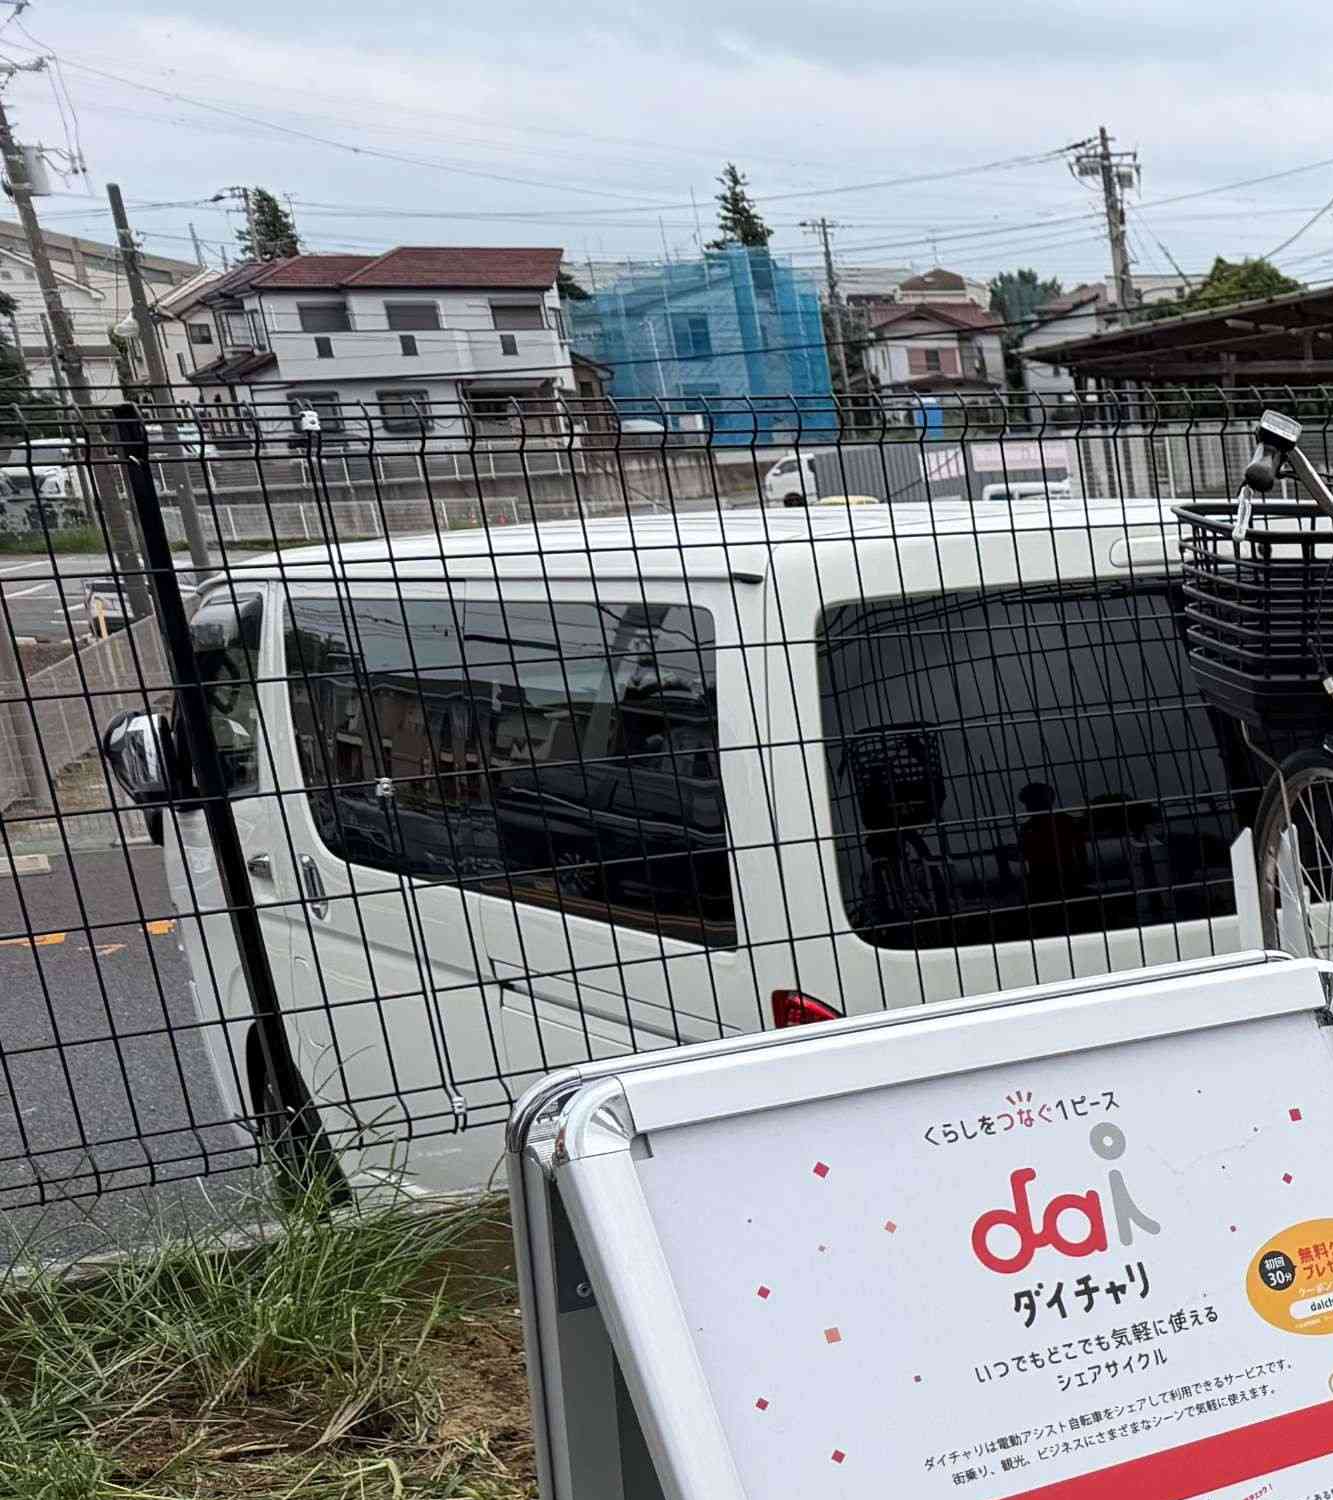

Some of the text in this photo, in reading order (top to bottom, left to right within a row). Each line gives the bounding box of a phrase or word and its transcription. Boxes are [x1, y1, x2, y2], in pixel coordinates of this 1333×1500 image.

[924, 1091, 1120, 1146] くらしをつなぐ1ピース
[1264, 1256, 1286, 1270] 初回
[1268, 1270, 1292, 1287] 30分
[1013, 1261, 1150, 1328] ダイチャリ
[974, 1305, 1219, 1384] いつでもどこでも気軽に使える
[1056, 1347, 1168, 1392] シェアサイクル
